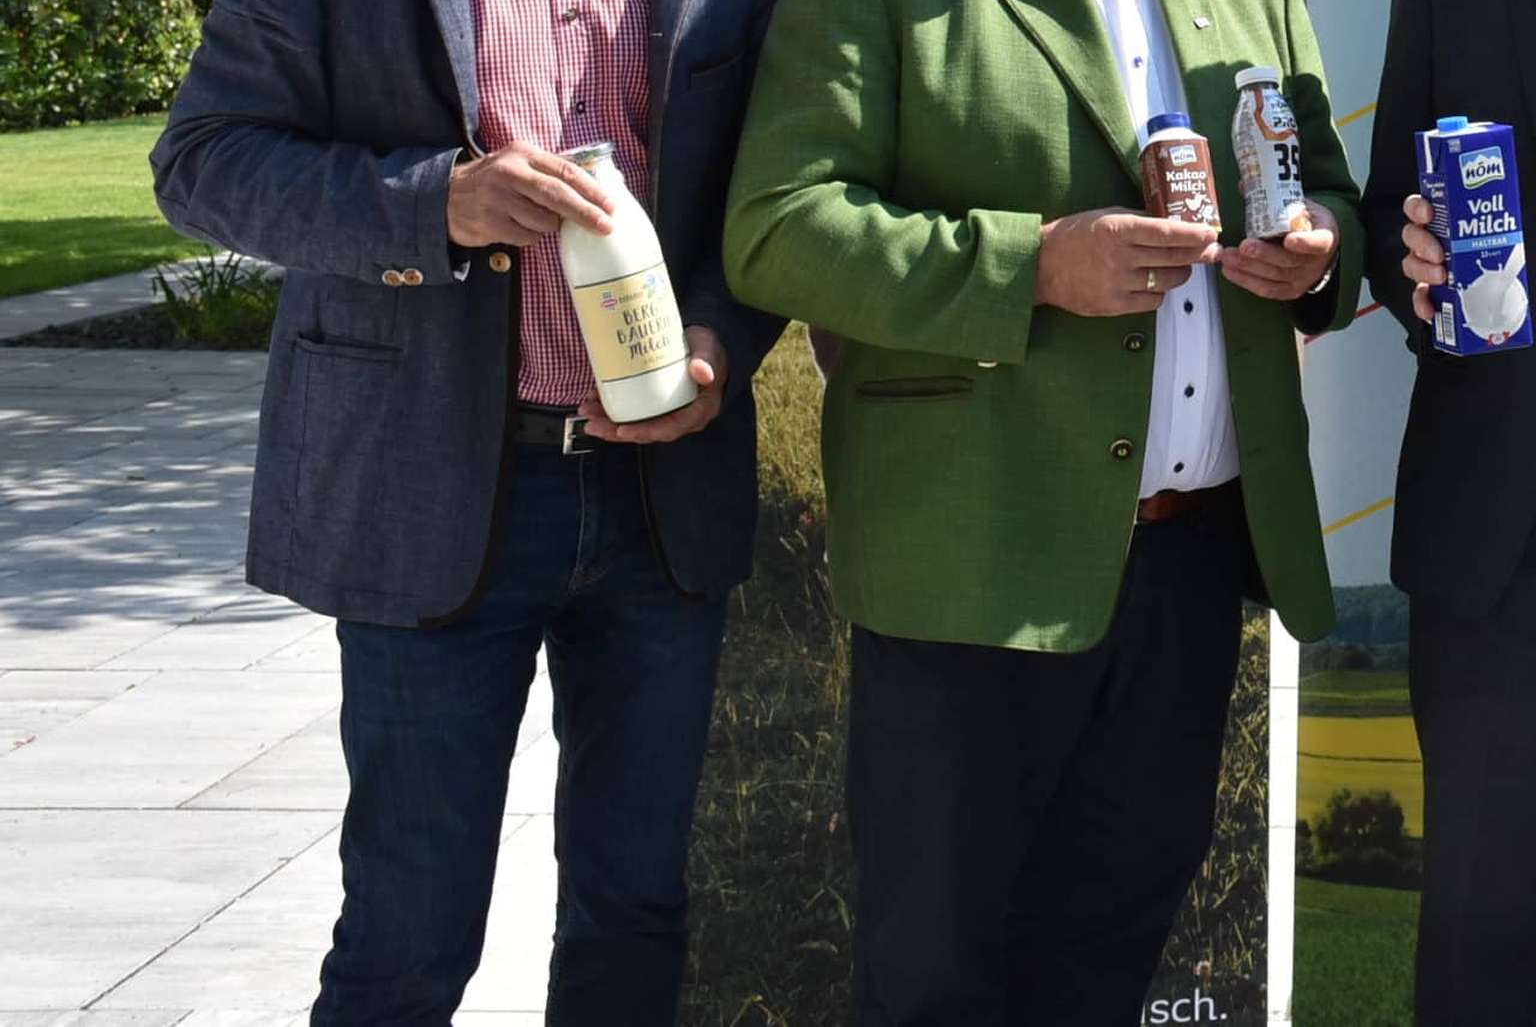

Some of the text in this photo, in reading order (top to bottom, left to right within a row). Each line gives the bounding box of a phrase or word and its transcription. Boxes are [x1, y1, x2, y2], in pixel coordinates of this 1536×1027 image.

[1165, 169, 1207, 183] Kakao
[1170, 177, 1206, 194] Milch
[1468, 195, 1504, 214] Voll
[1458, 213, 1517, 237] Milch
